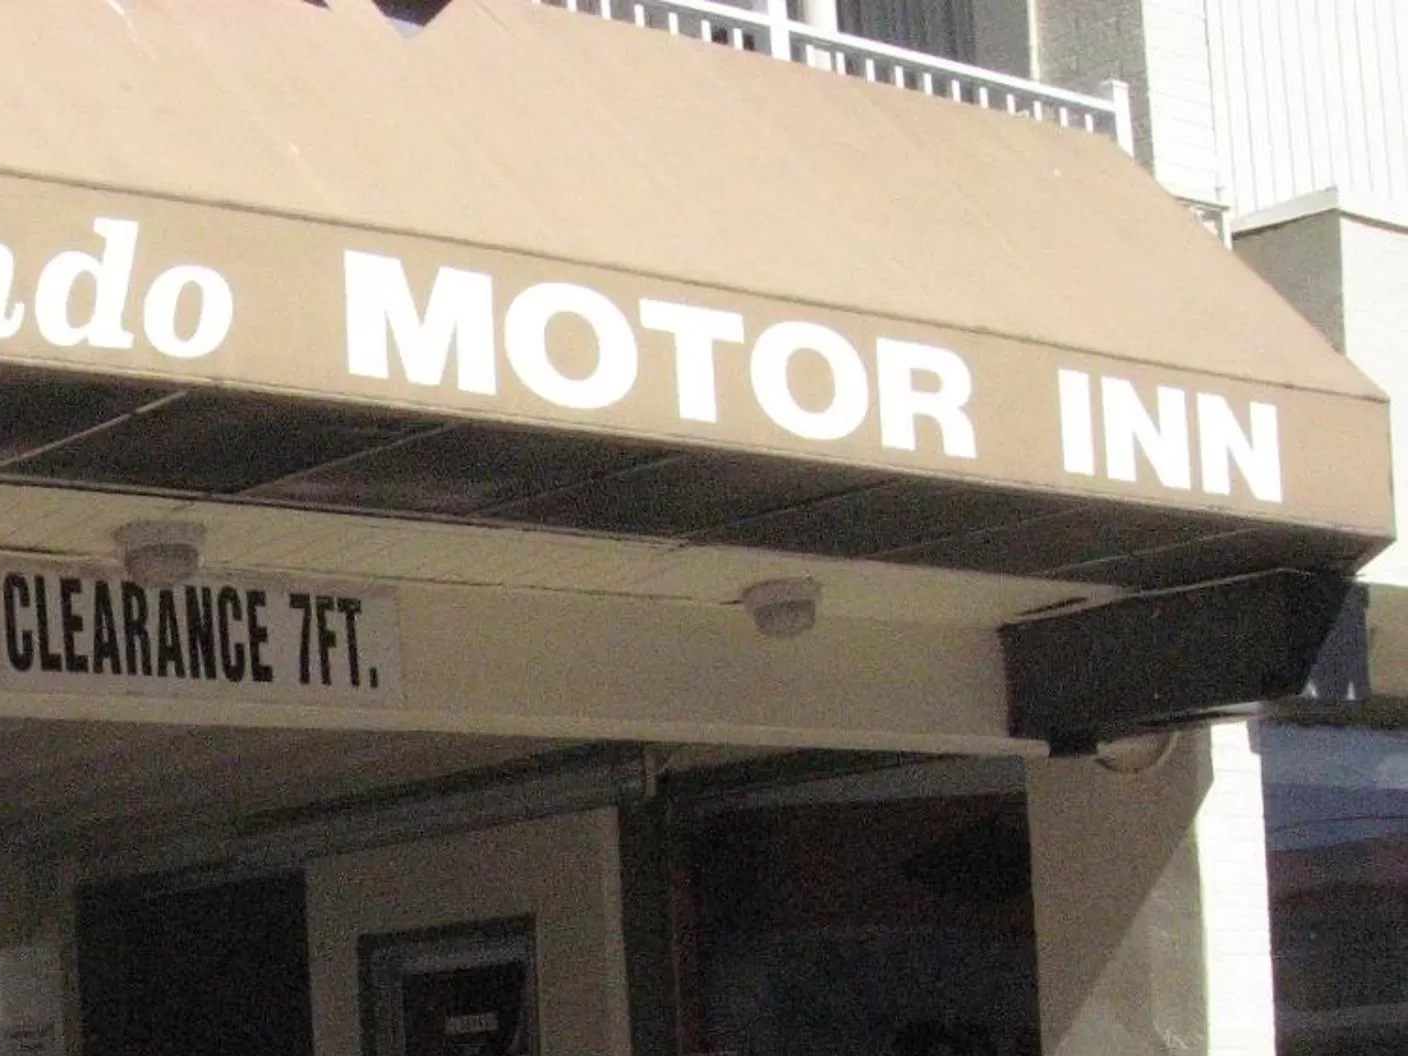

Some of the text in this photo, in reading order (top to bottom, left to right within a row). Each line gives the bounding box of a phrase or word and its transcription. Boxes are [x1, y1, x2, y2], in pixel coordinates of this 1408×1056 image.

[343, 249, 978, 459] MOTOR
[1057, 368, 1283, 503] INN
[2, 571, 274, 683] CLEARANCE
